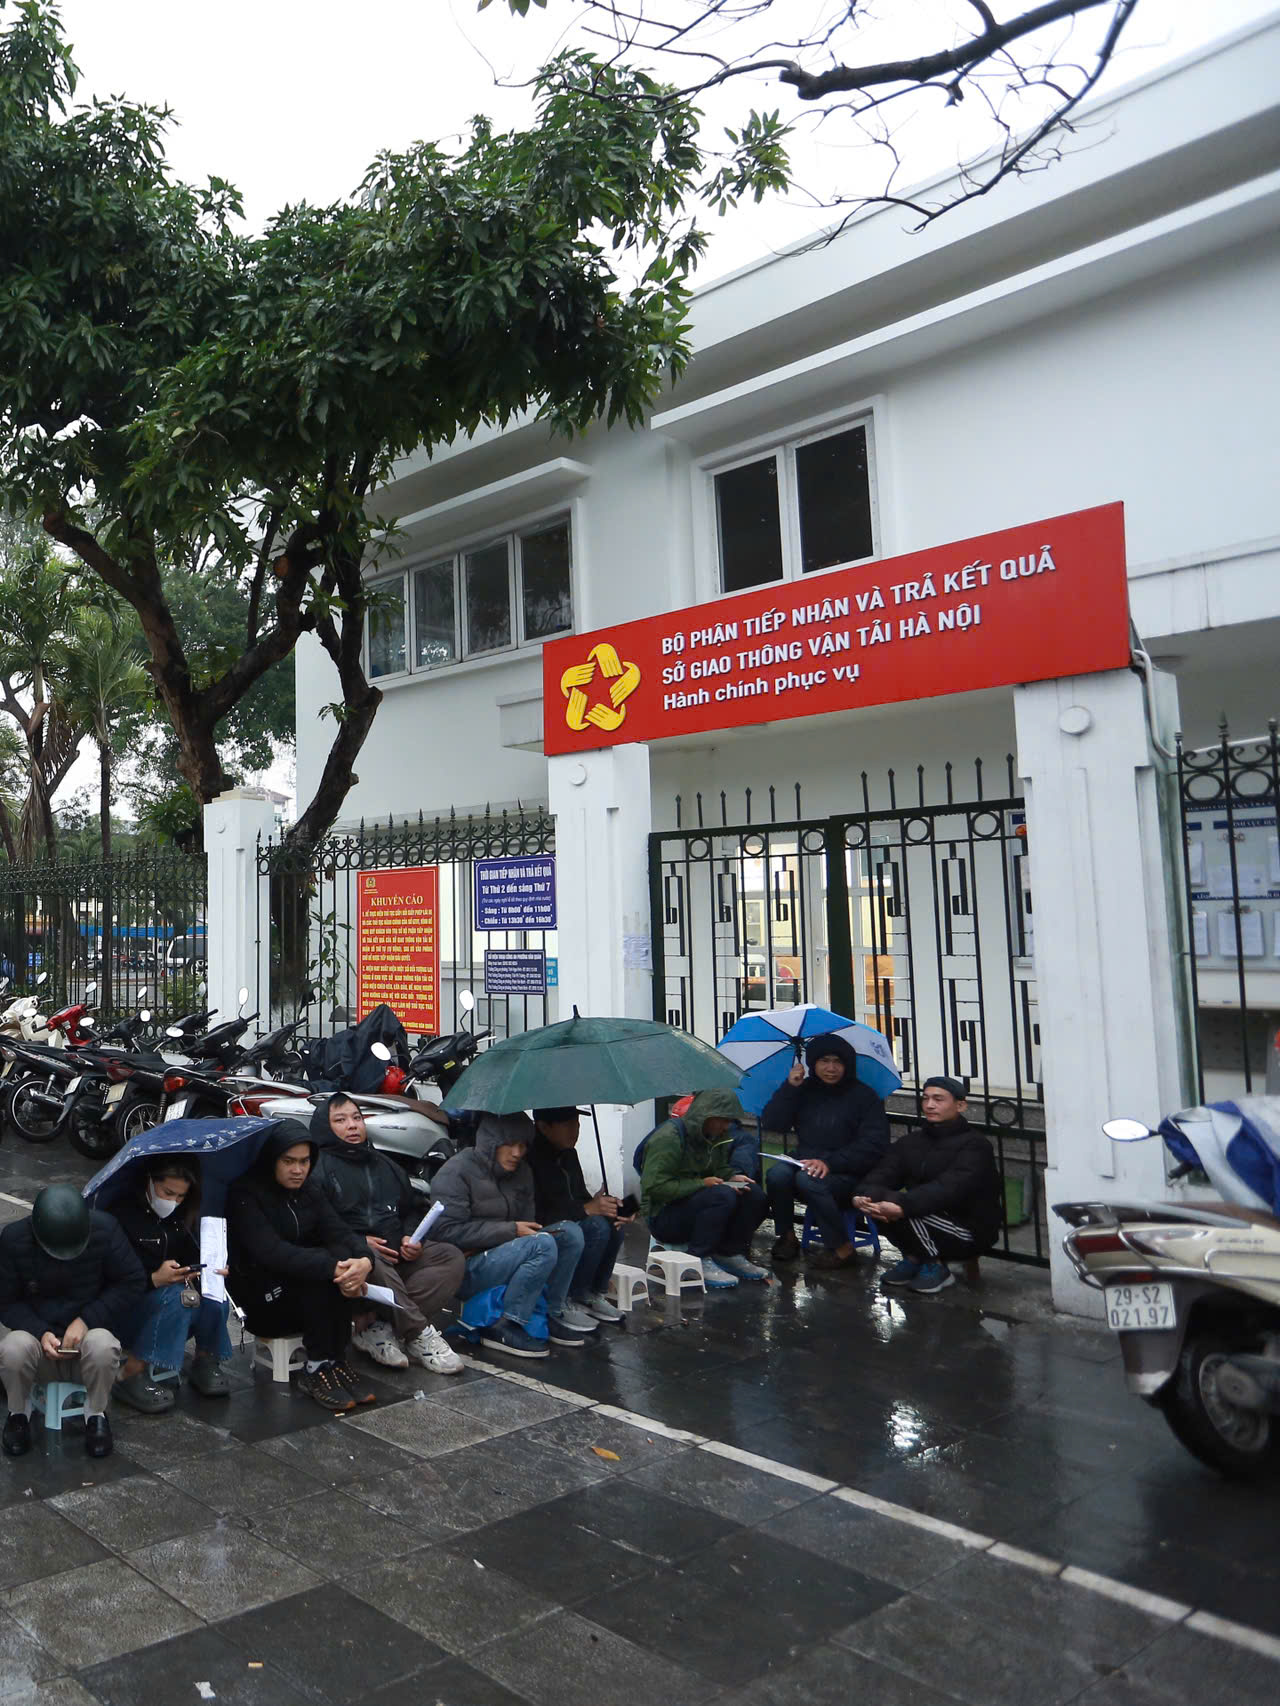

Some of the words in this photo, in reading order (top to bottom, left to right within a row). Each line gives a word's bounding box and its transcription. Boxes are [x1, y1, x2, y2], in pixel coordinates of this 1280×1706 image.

[662, 632, 685, 655] BỘ
[691, 622, 738, 649] PHẬN
[743, 607, 787, 637] TIẾP
[792, 596, 849, 624] NHẬN
[856, 585, 885, 612] VÀ
[890, 572, 937, 605] TRẢ
[944, 560, 993, 594] KẾT
[1000, 545, 1056, 580] QUẢ
[663, 661, 686, 686] SỞ
[691, 654, 732, 679] GIAO
[736, 640, 803, 671] THÔNG
[808, 632, 851, 657] VẬN
[856, 619, 892, 647] TẢI
[900, 612, 931, 639] HÀ
[939, 603, 981, 631] NỘI
[664, 689, 710, 711] Hành
[715, 681, 769, 702] chính
[775, 671, 827, 696] phục
[832, 664, 860, 685] vụ
[501, 885, 505, 893] 2
[546, 882, 551, 891] 7
[1111, 1305, 1169, 1327] 021.97
